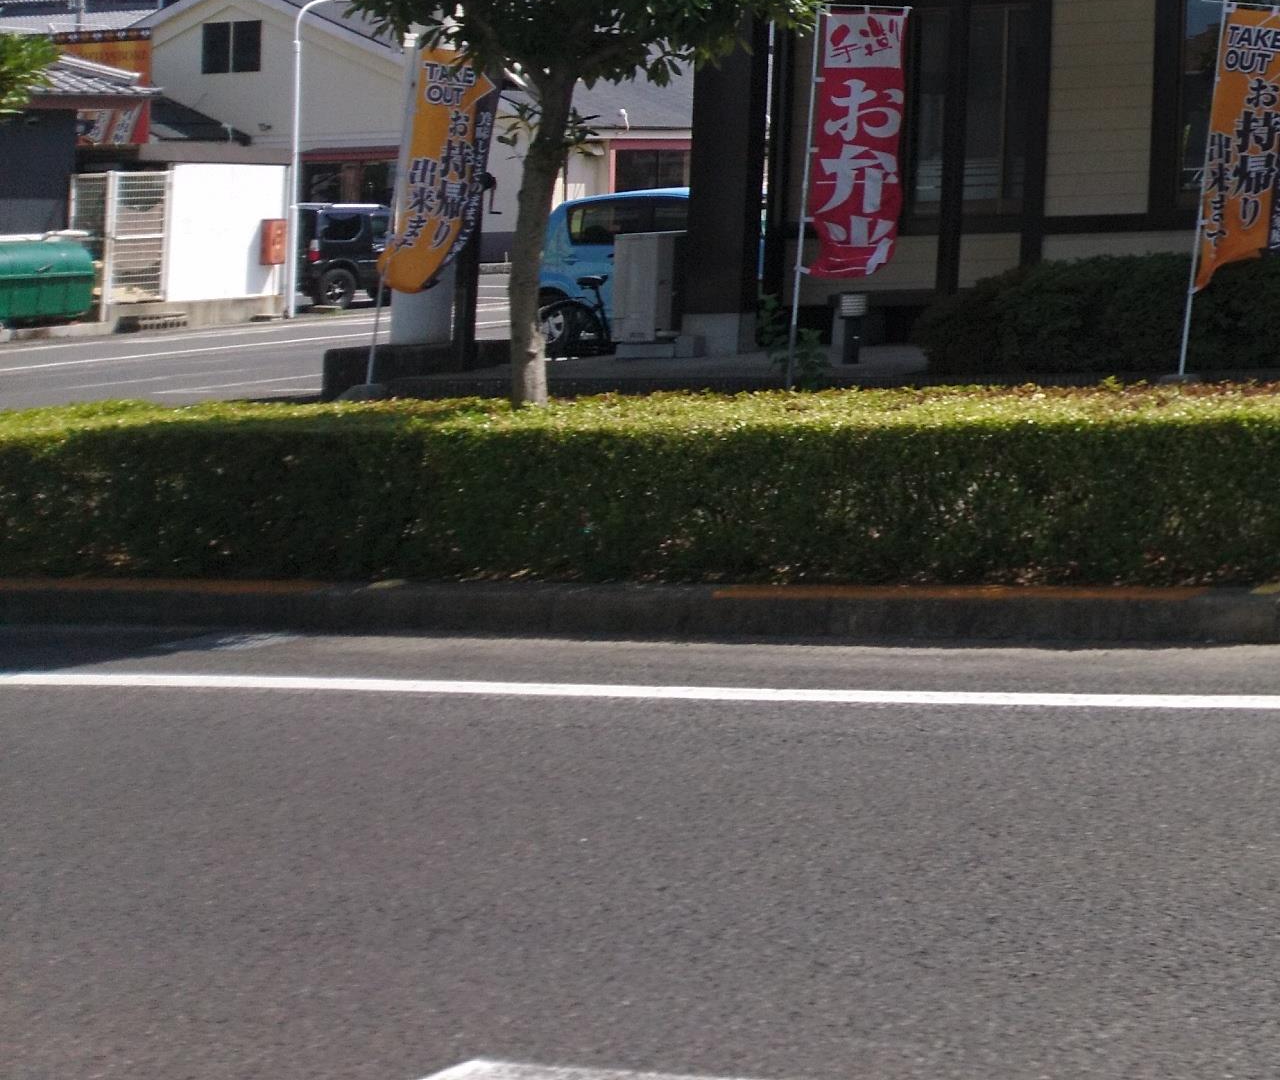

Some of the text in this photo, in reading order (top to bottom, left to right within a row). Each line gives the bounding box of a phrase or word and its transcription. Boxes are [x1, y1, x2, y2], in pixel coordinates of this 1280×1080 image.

[424, 62, 477, 85] TAKE
[1225, 49, 1273, 74] OUT
[426, 84, 465, 106] OUT
[813, 78, 905, 276] お弁当
